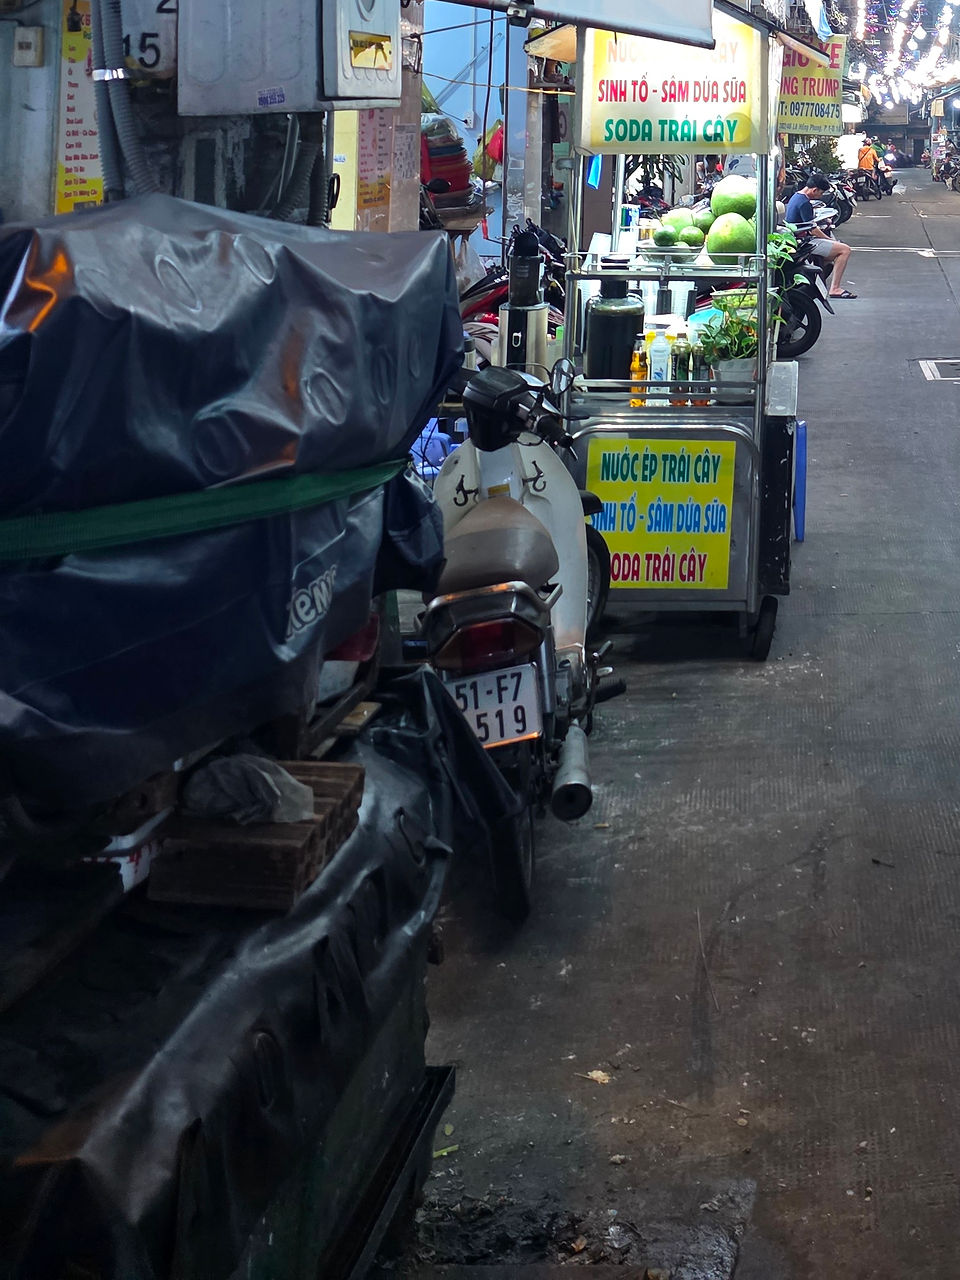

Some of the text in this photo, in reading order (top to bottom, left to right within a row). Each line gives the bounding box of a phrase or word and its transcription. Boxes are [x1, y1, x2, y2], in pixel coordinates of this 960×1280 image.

[598, 79, 627, 103] SINH
[631, 71, 649, 103] TỐ
[661, 75, 689, 103] SÂM
[802, 77, 840, 98] TRUMP
[604, 114, 739, 142] SODA TRÁI CÂY
[790, 101, 840, 119] 0977708475
[600, 446, 721, 483] NƯỚC ÉP TRÁI CÂY
[620, 491, 637, 532] TỐ
[647, 497, 674, 533] SÂM
[703, 499, 727, 533] SỮA
[610, 546, 708, 582] ODA TRÁI CÂY
[455, 671, 523, 712] 51-F7
[476, 705, 527, 742] 519
